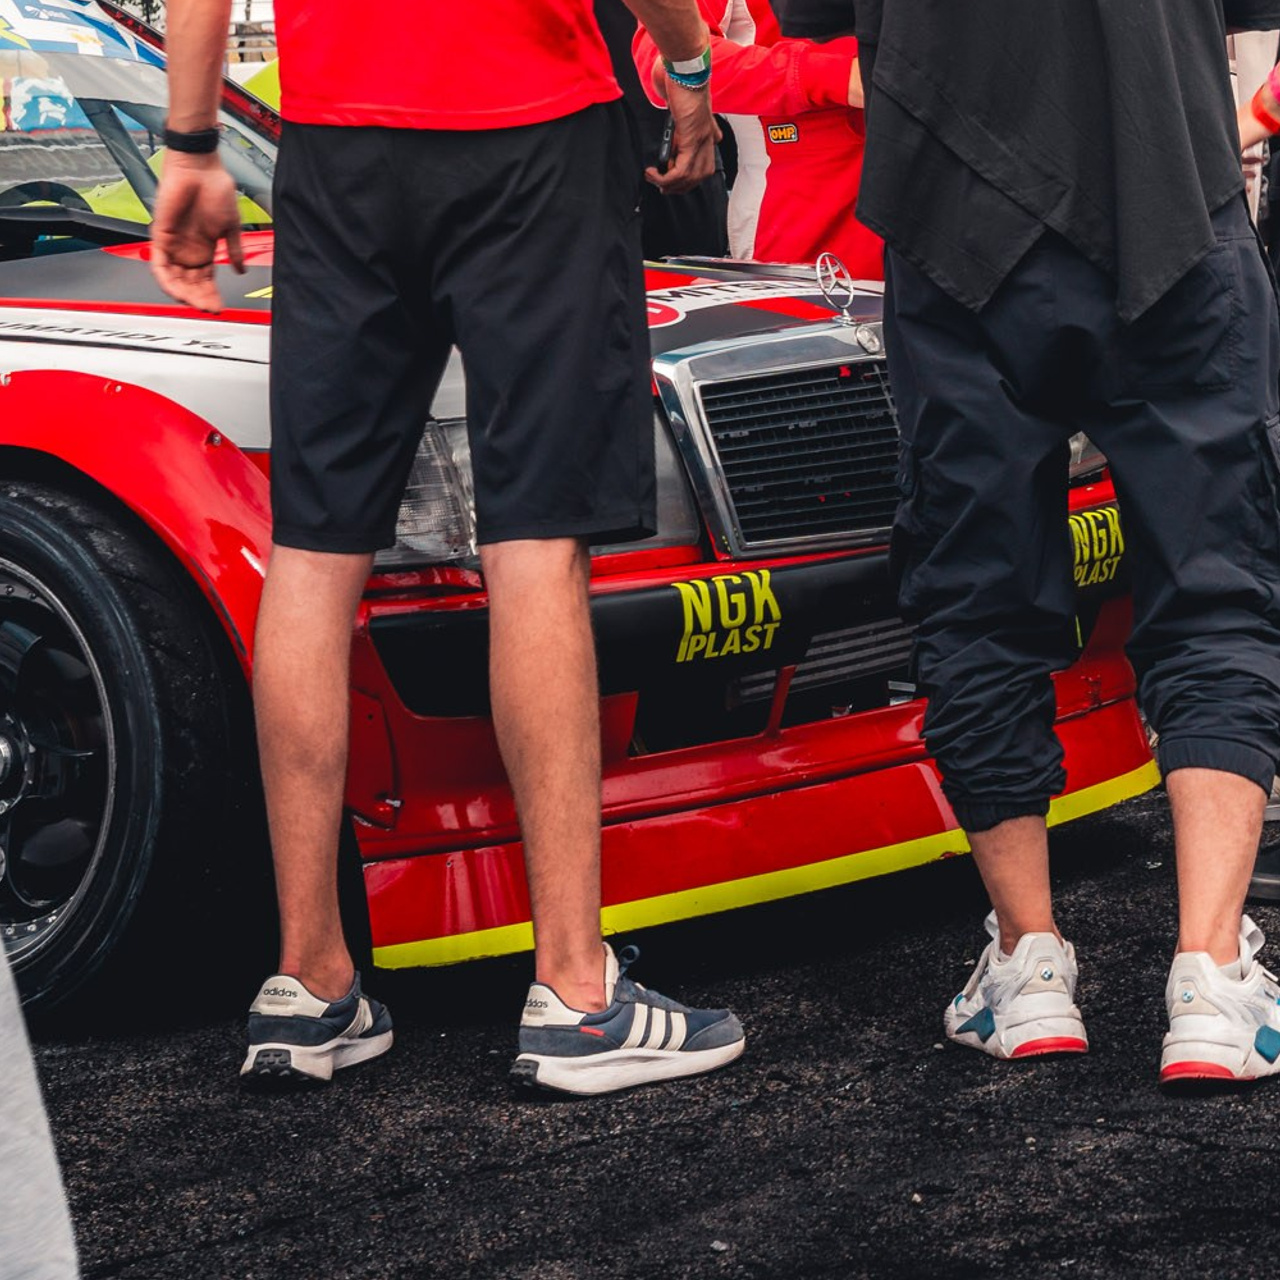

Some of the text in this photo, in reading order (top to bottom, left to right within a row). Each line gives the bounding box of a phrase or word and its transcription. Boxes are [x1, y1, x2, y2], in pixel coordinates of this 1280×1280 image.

[771, 126, 795, 140] OMP
[1069, 506, 1125, 565] NGK
[671, 569, 782, 634] NGK
[263, 986, 298, 998] adidas
